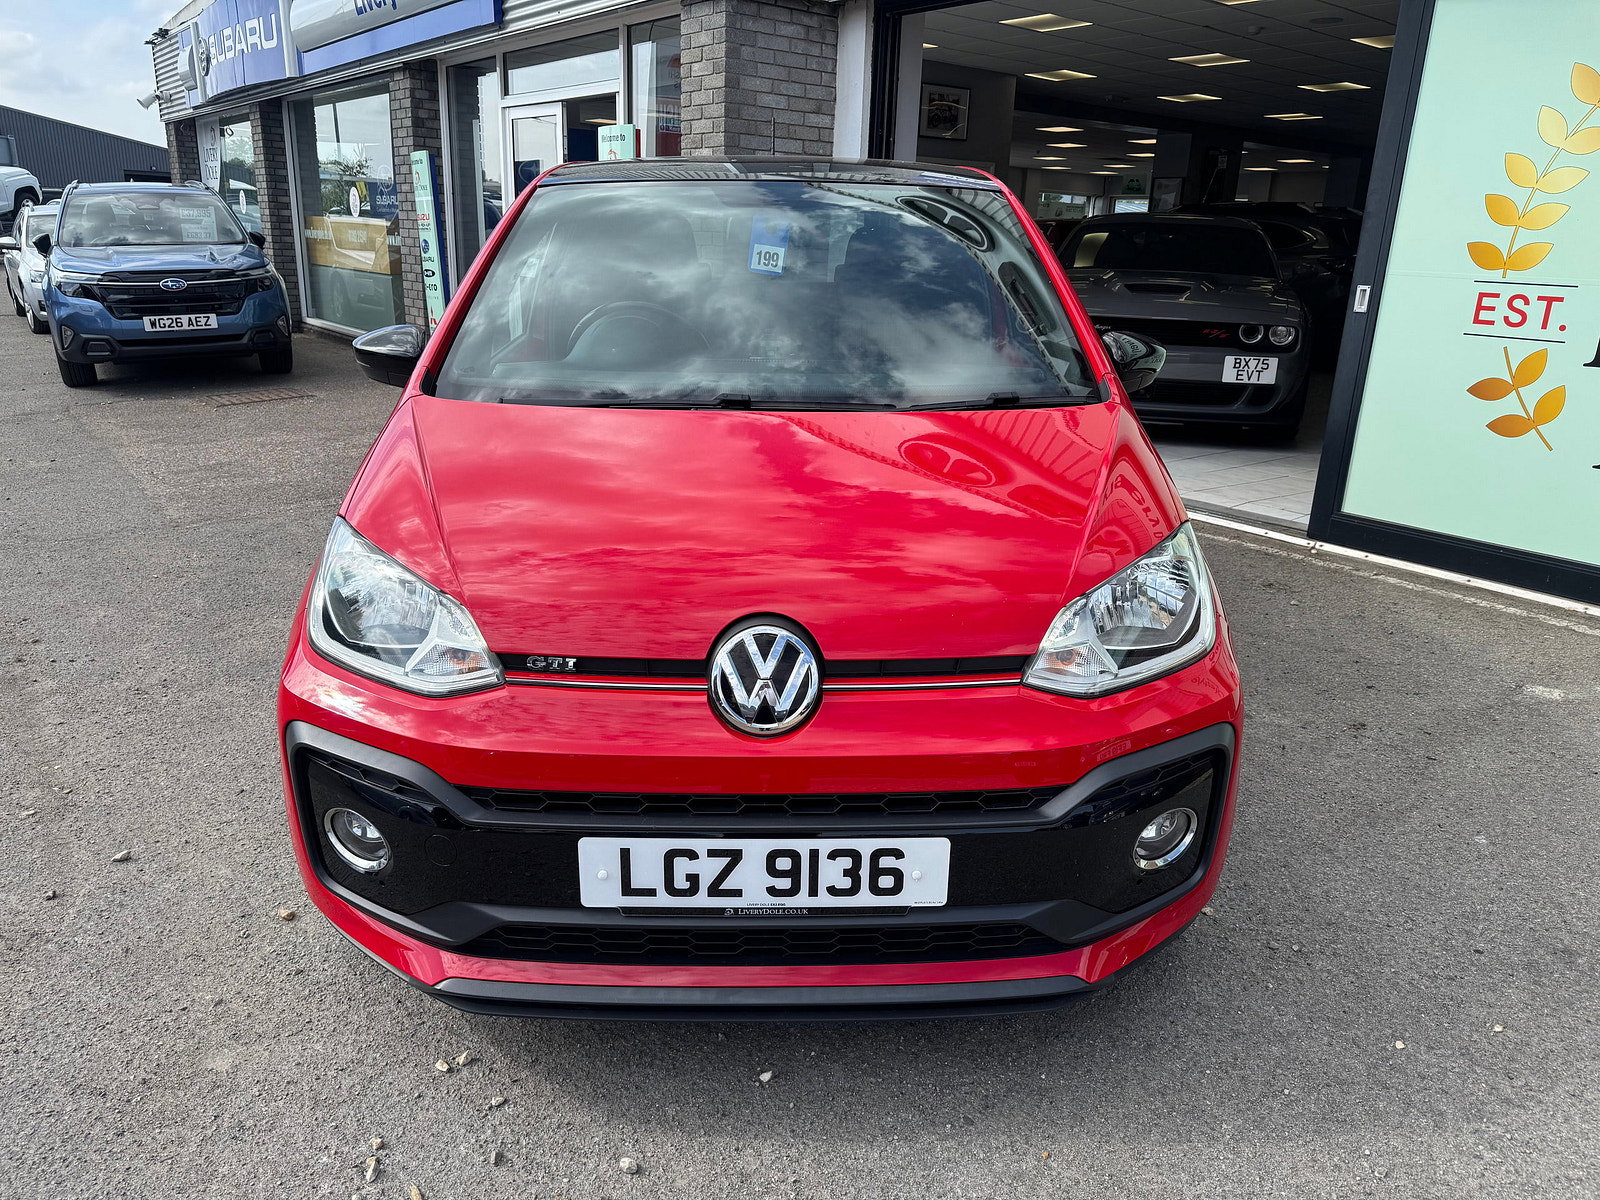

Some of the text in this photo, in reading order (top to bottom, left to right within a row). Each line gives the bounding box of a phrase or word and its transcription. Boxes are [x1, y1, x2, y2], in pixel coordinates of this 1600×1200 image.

[207, 13, 278, 66] SUBARU
[620, 133, 626, 142] to
[756, 250, 780, 268] 199
[1472, 291, 1567, 332] EST.
[149, 316, 212, 330] WG26 AEZ
[1233, 357, 1270, 371] BX75
[1235, 370, 1264, 382] EVT
[526, 655, 577, 672] GTI
[619, 847, 906, 898] LGZ 9136
